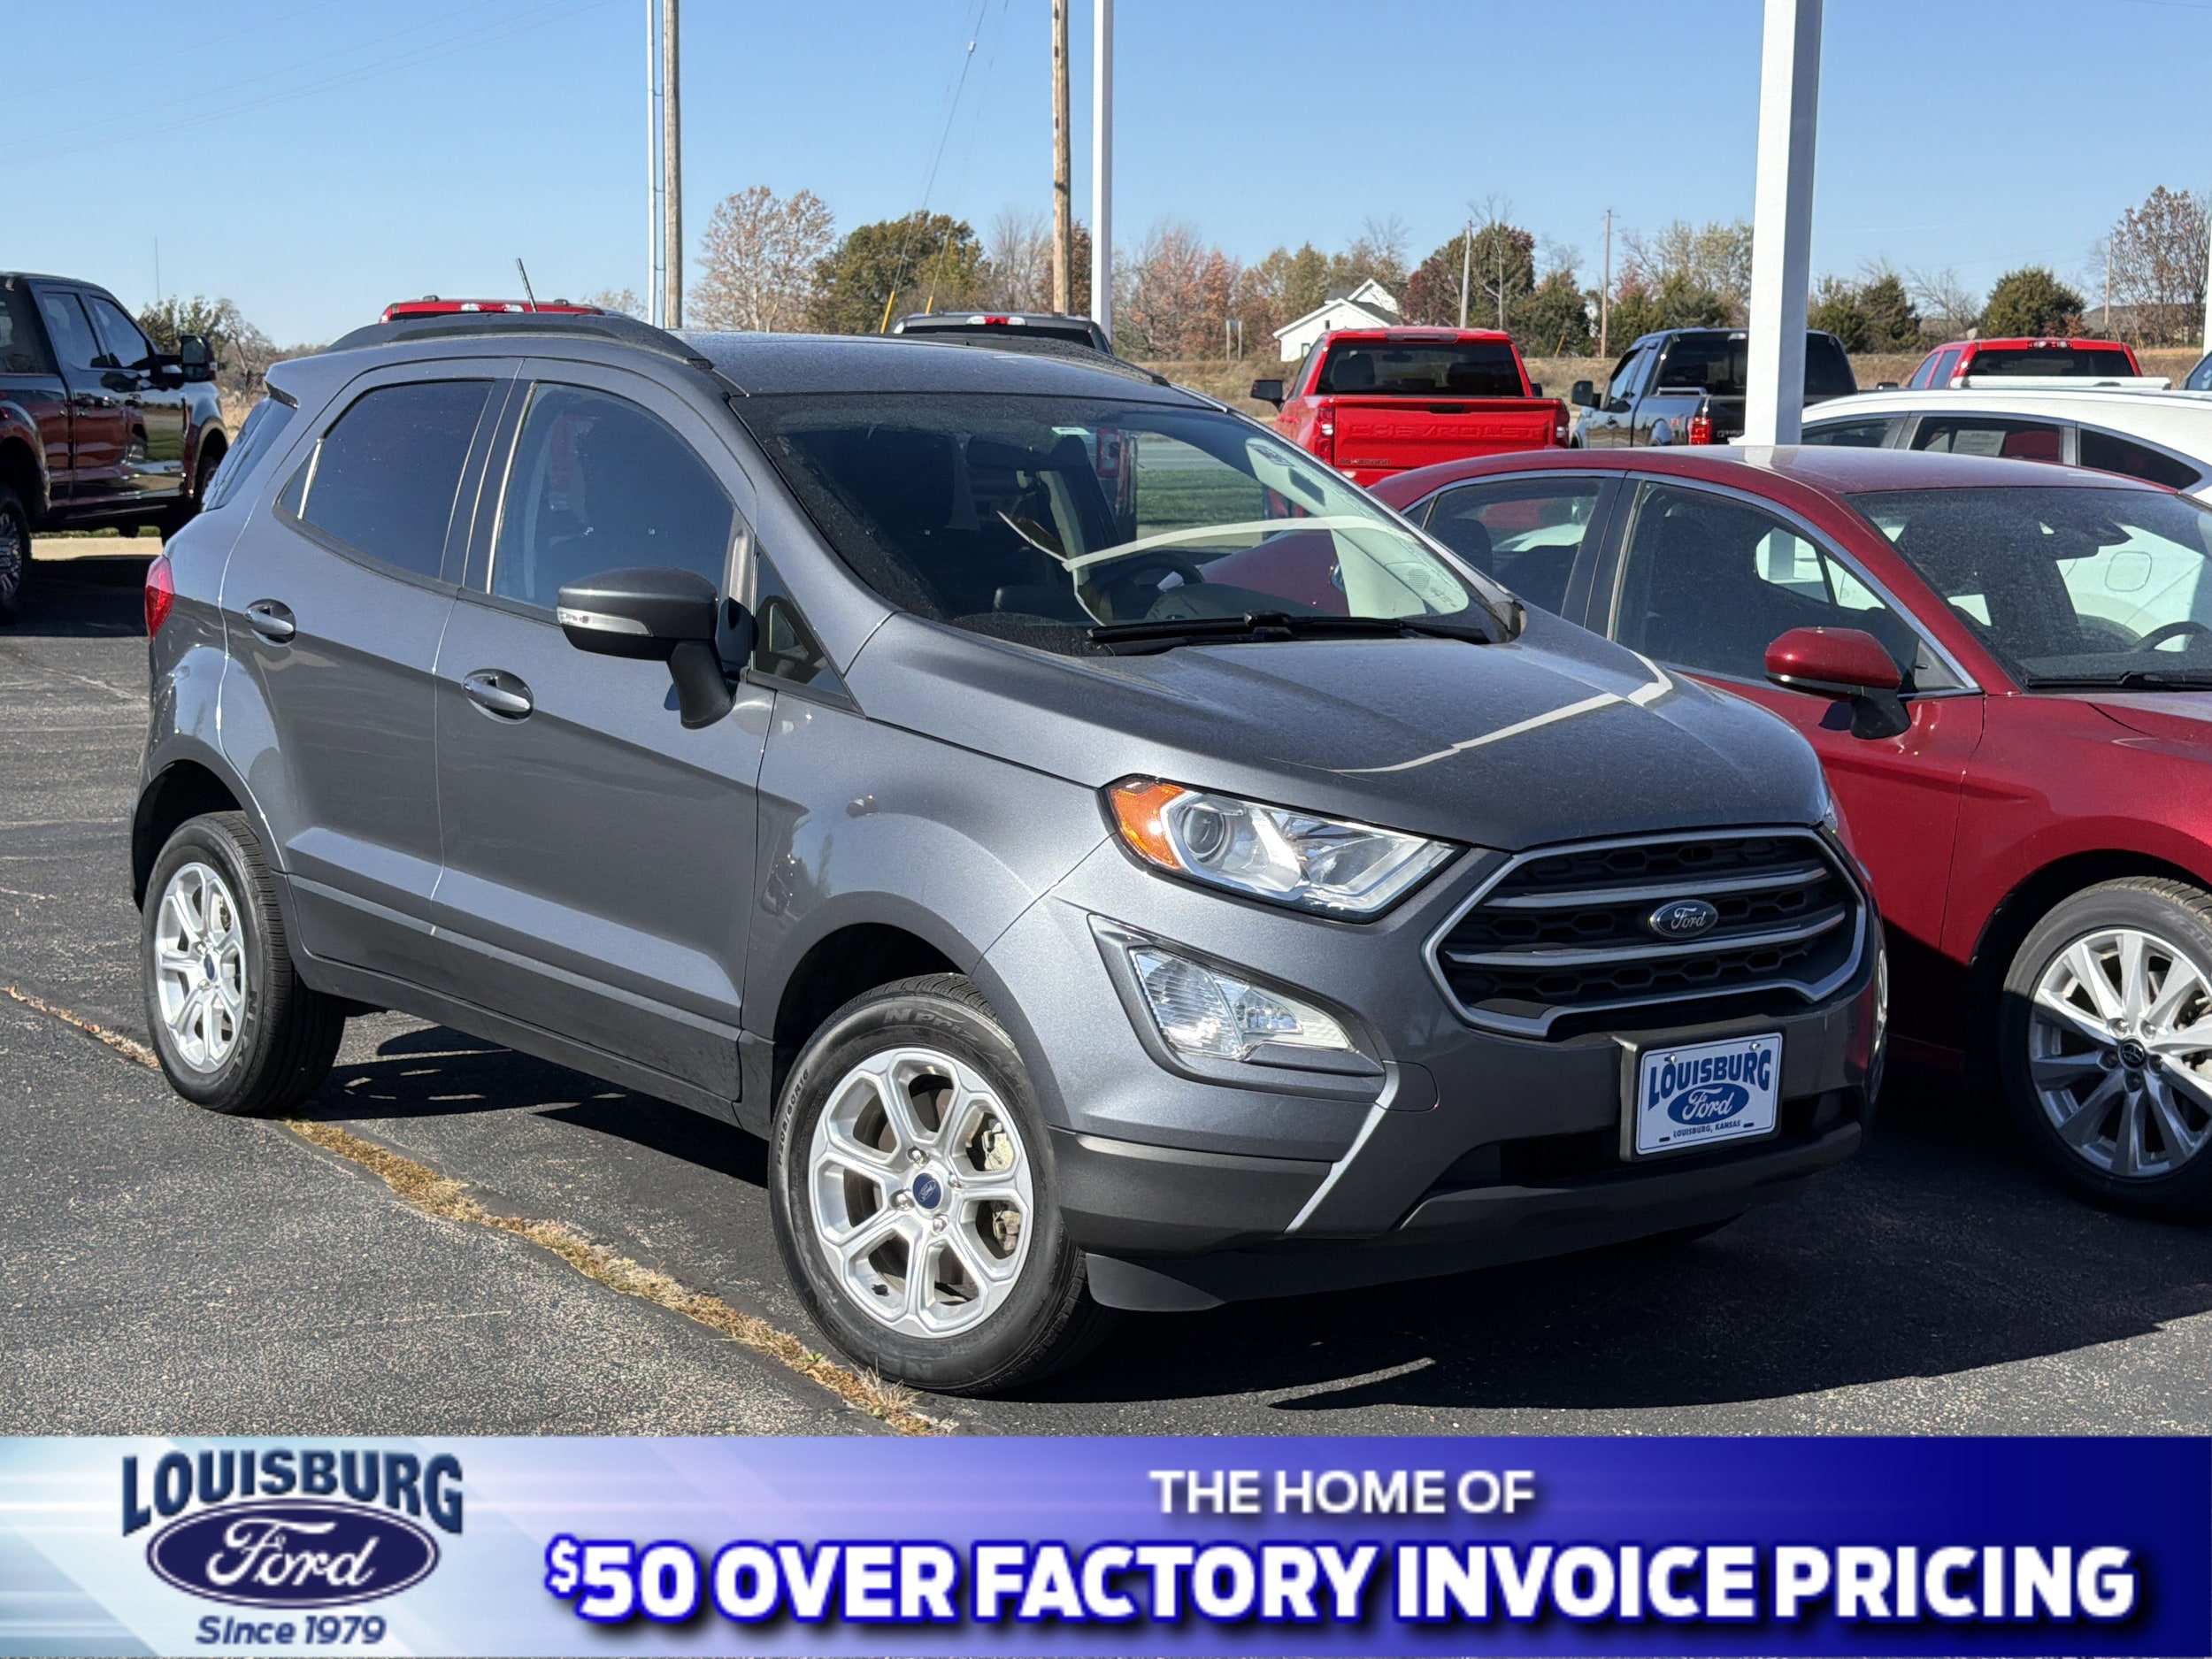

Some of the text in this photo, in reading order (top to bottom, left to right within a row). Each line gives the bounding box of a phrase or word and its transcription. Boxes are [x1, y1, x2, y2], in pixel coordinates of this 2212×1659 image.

[1670, 906, 1707, 930] Ford
[1647, 1049, 1772, 1111] LOUISBURG
[1681, 1086, 1733, 1121] Ford
[1715, 1119, 1741, 1132] KANSAS
